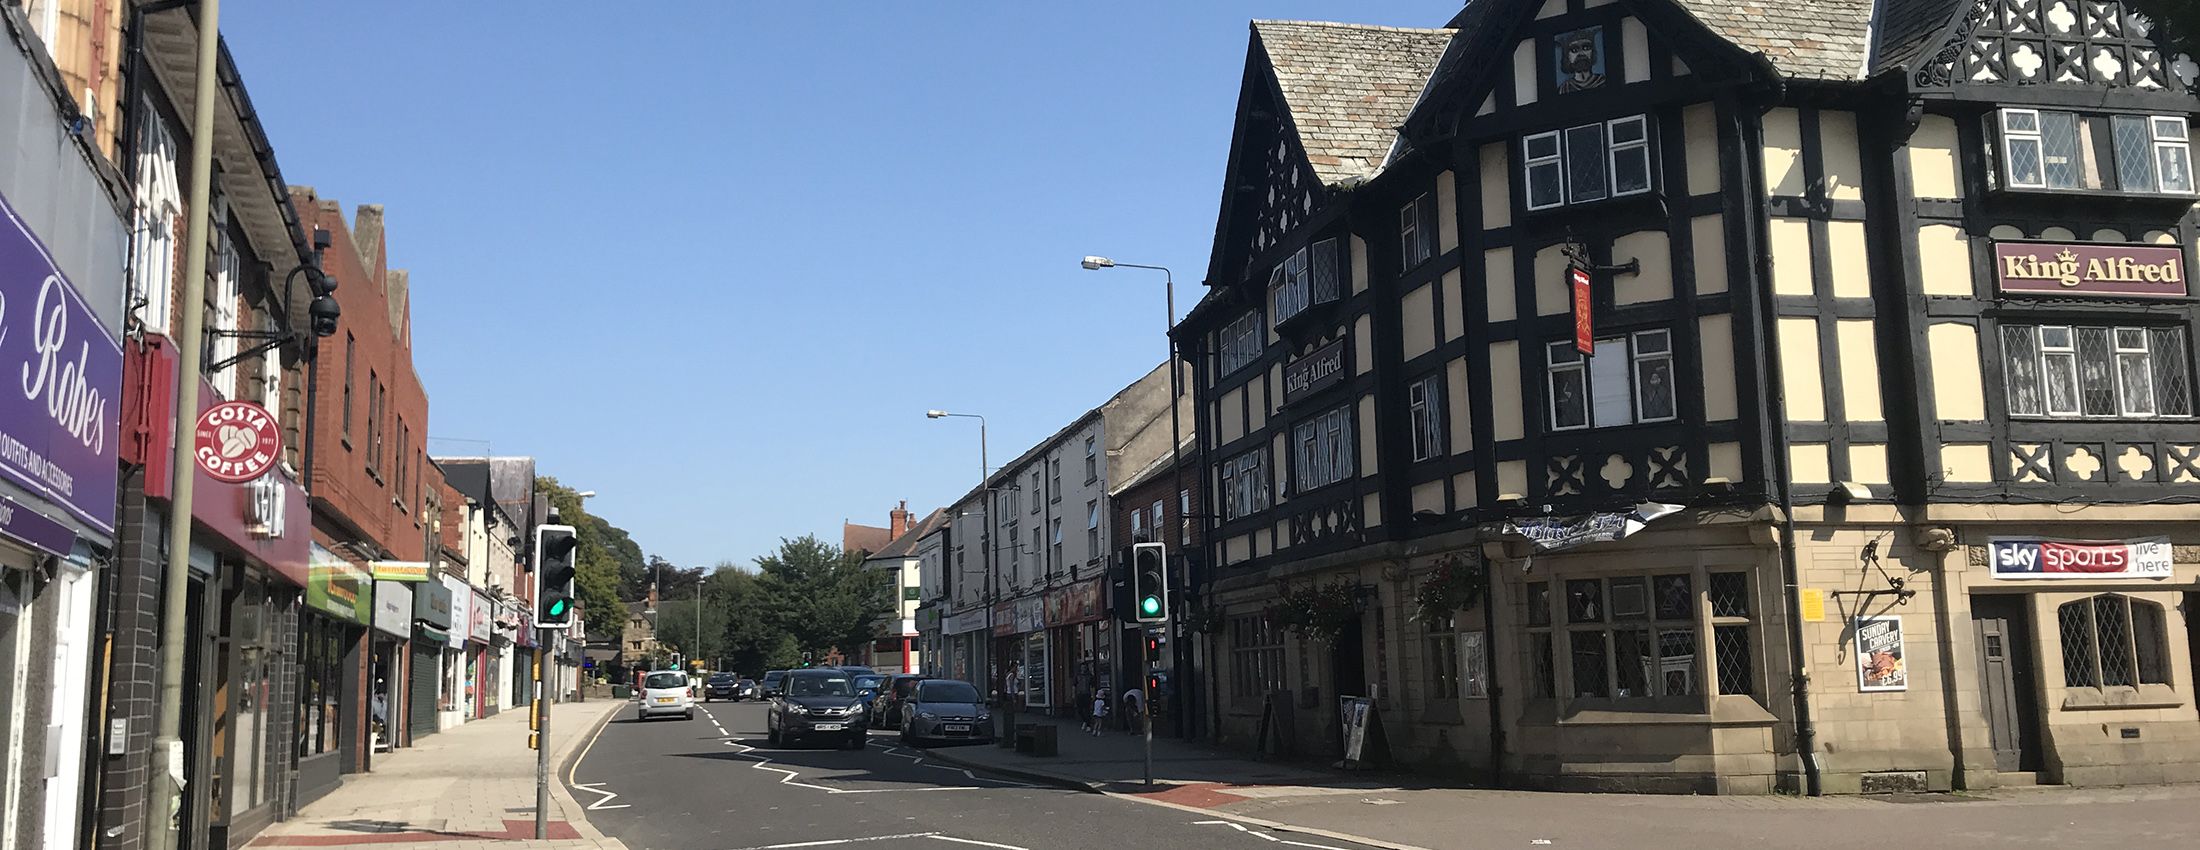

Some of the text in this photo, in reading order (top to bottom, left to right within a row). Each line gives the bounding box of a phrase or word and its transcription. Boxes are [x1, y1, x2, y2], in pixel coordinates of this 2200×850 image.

[2003, 254, 2180, 286] King Alfred
[22, 273, 106, 456] Robes
[1286, 350, 1342, 394] King Alfred
[208, 406, 268, 432] COSTA
[1, 433, 74, 498] OUTFITS AND ACCESSORIES
[198, 446, 270, 476] COFFEE
[2000, 543, 2125, 571] sky sports
[2135, 543, 2159, 556] live
[2136, 558, 2170, 573] here
[1861, 620, 1890, 641] SUNDAY
[1869, 629, 1899, 649] CARVERY
[1881, 669, 1903, 686] £6.99
